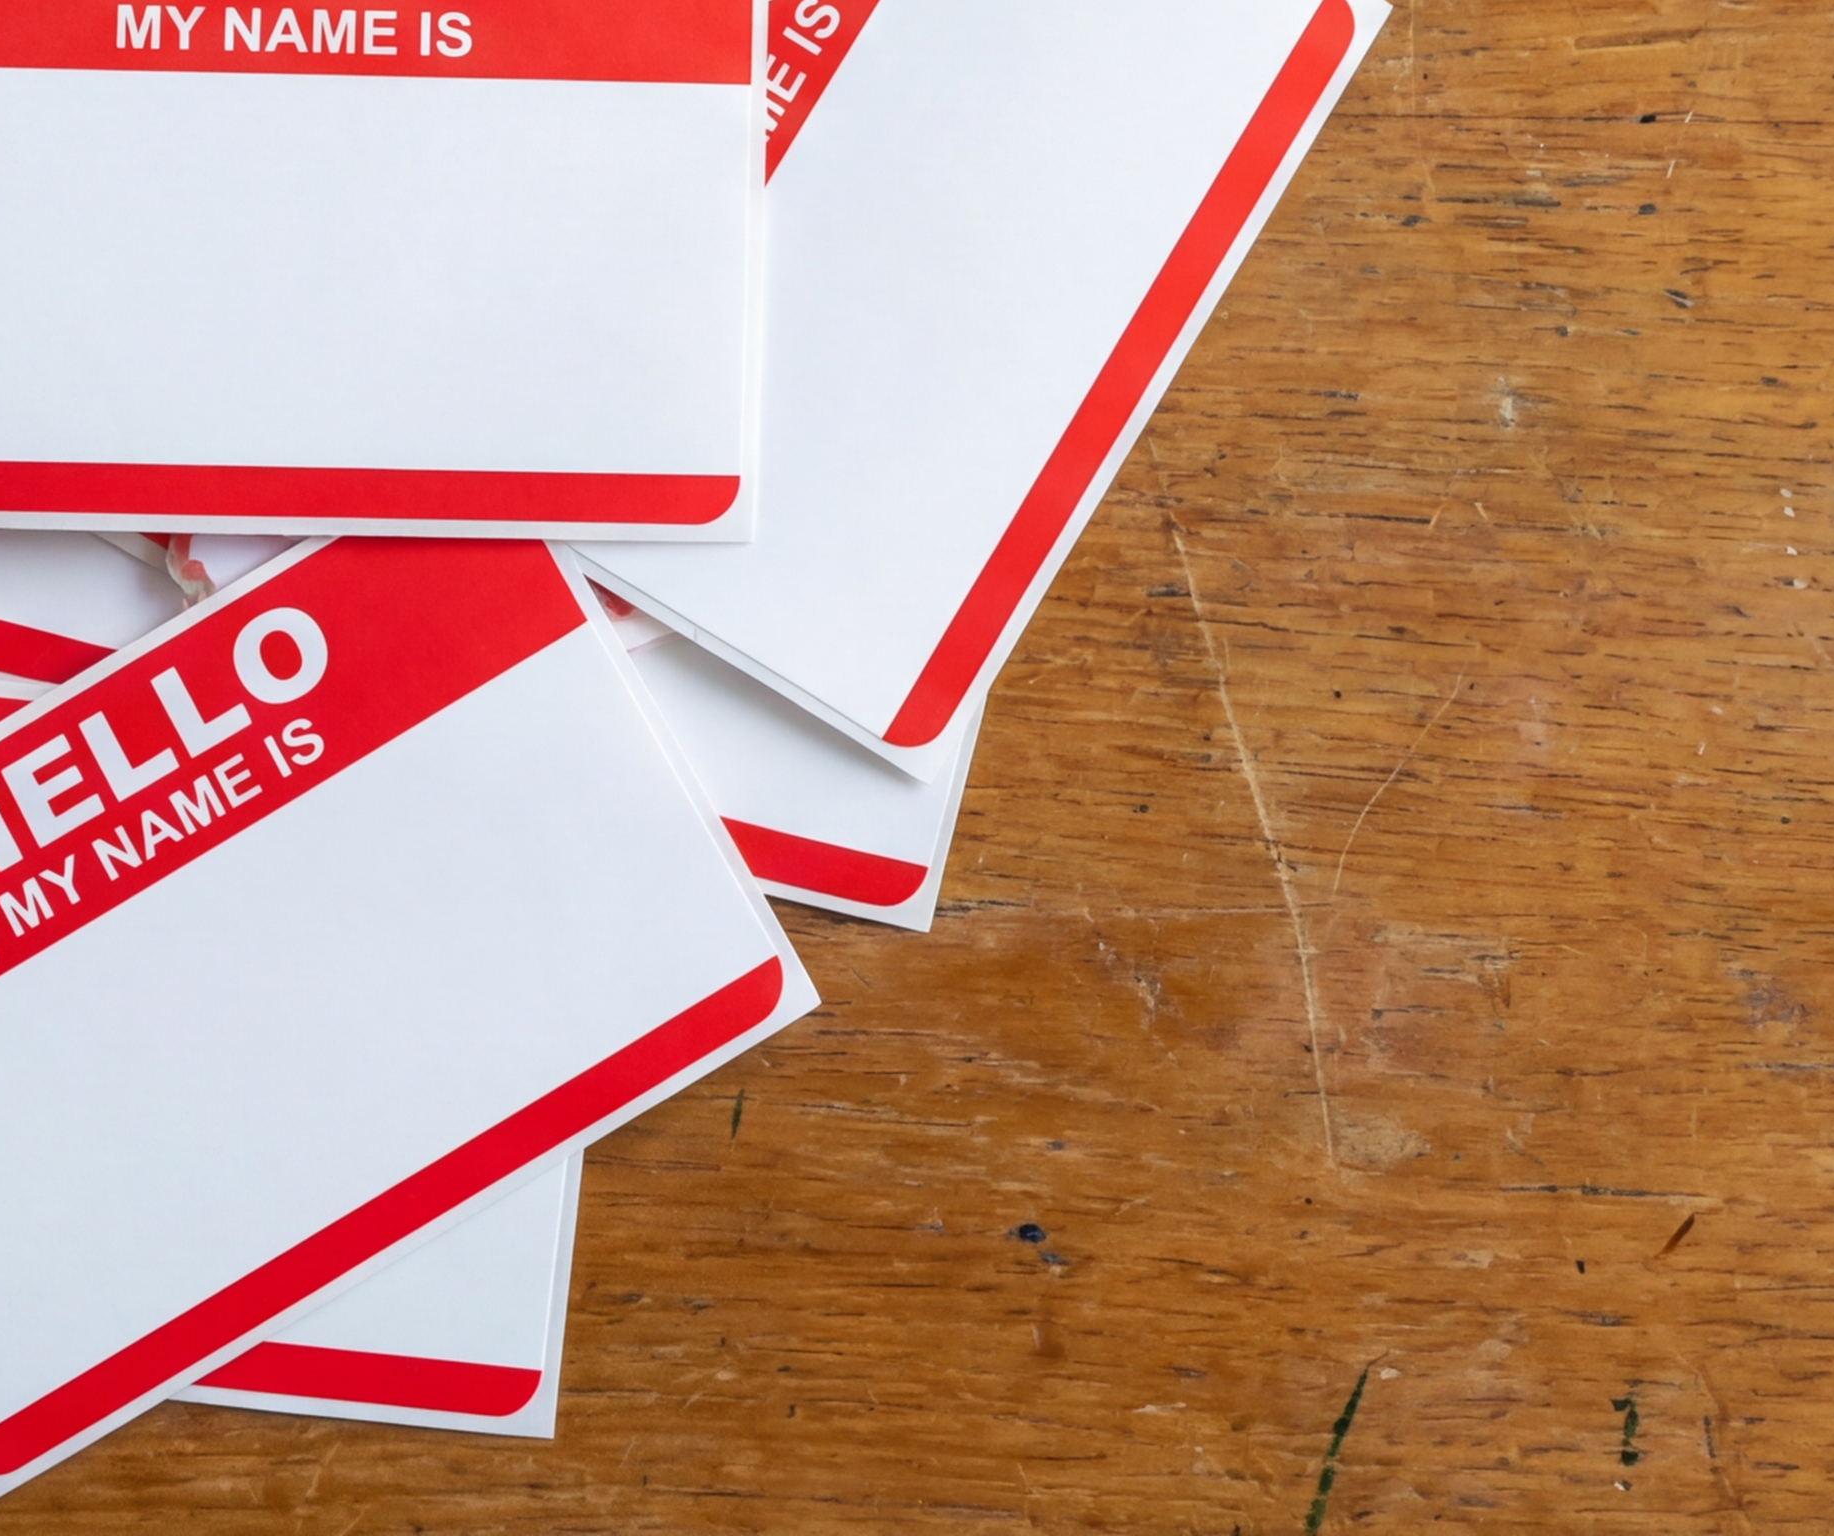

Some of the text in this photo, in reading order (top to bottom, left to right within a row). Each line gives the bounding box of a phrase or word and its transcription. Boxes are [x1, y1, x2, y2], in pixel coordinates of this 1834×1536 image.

[117, 4, 472, 57] MY NAME IS
[92, 754, 262, 880] NAME
[264, 719, 324, 777] IS
